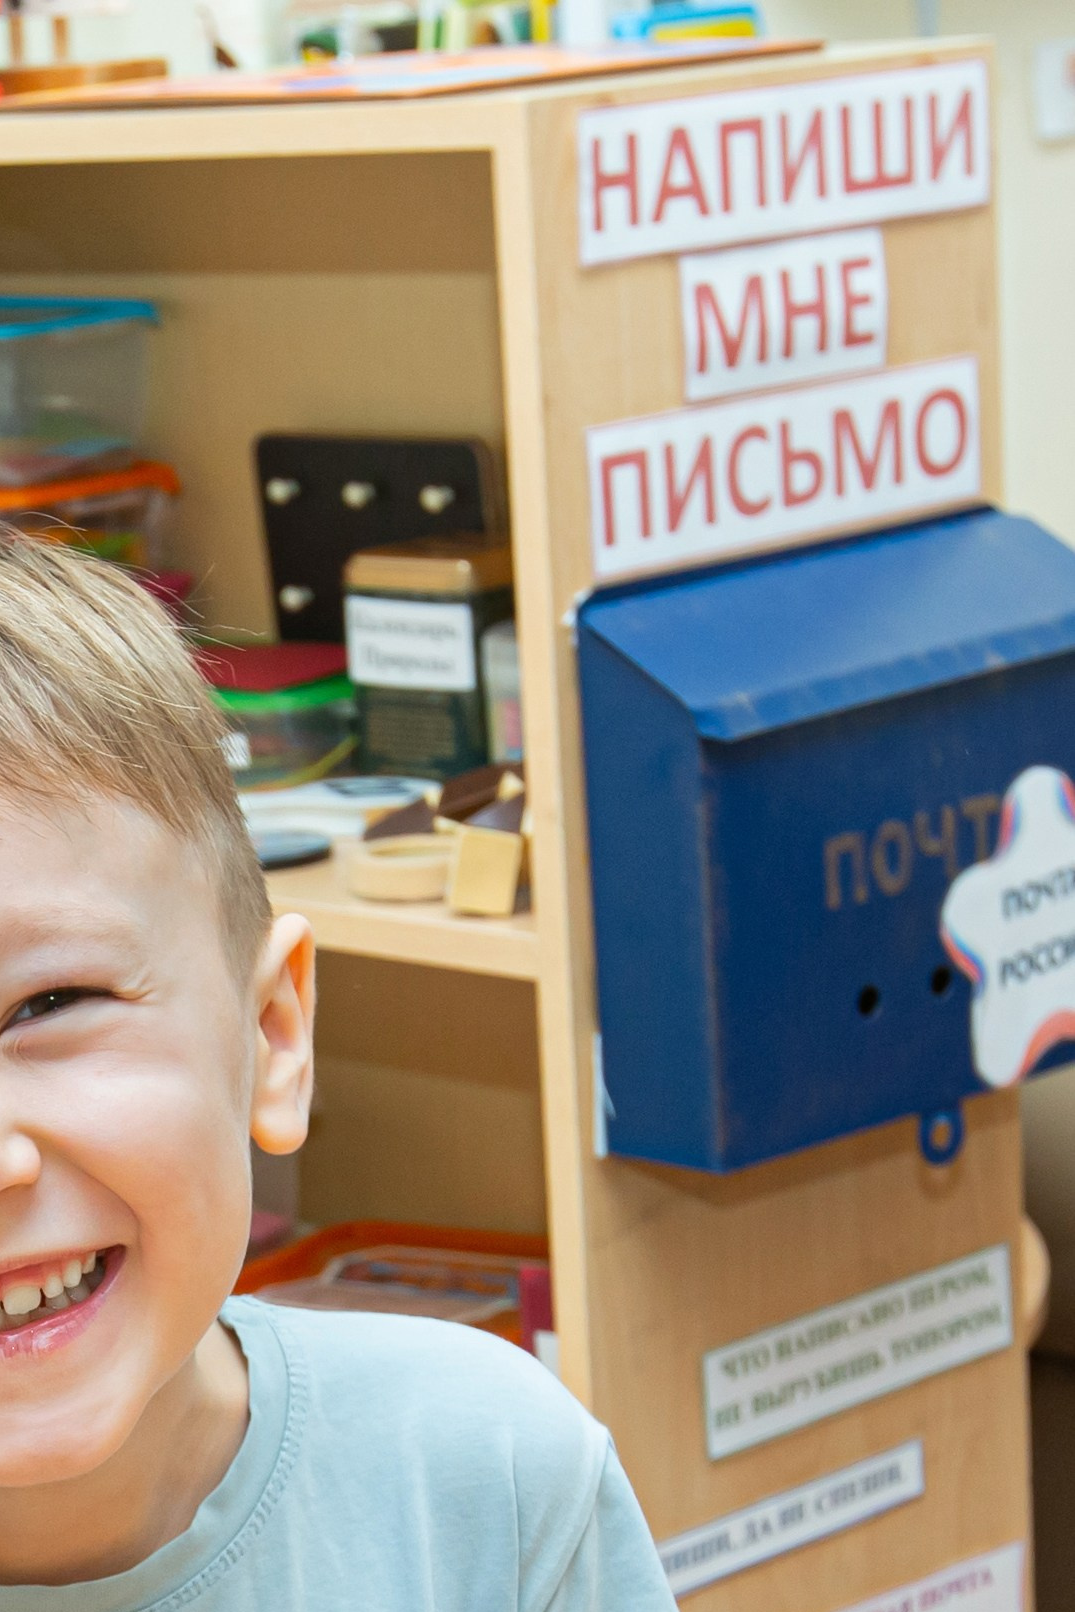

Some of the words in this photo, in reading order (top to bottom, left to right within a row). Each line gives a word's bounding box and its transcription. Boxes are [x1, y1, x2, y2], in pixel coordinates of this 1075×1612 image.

[591, 89, 975, 233] НАПИШИ
[694, 257, 875, 375] МНЕ
[600, 388, 968, 547] ПИСЬМО
[823, 794, 1001, 911] ПОЧТ
[1000, 864, 1075, 920] ПОЧТ
